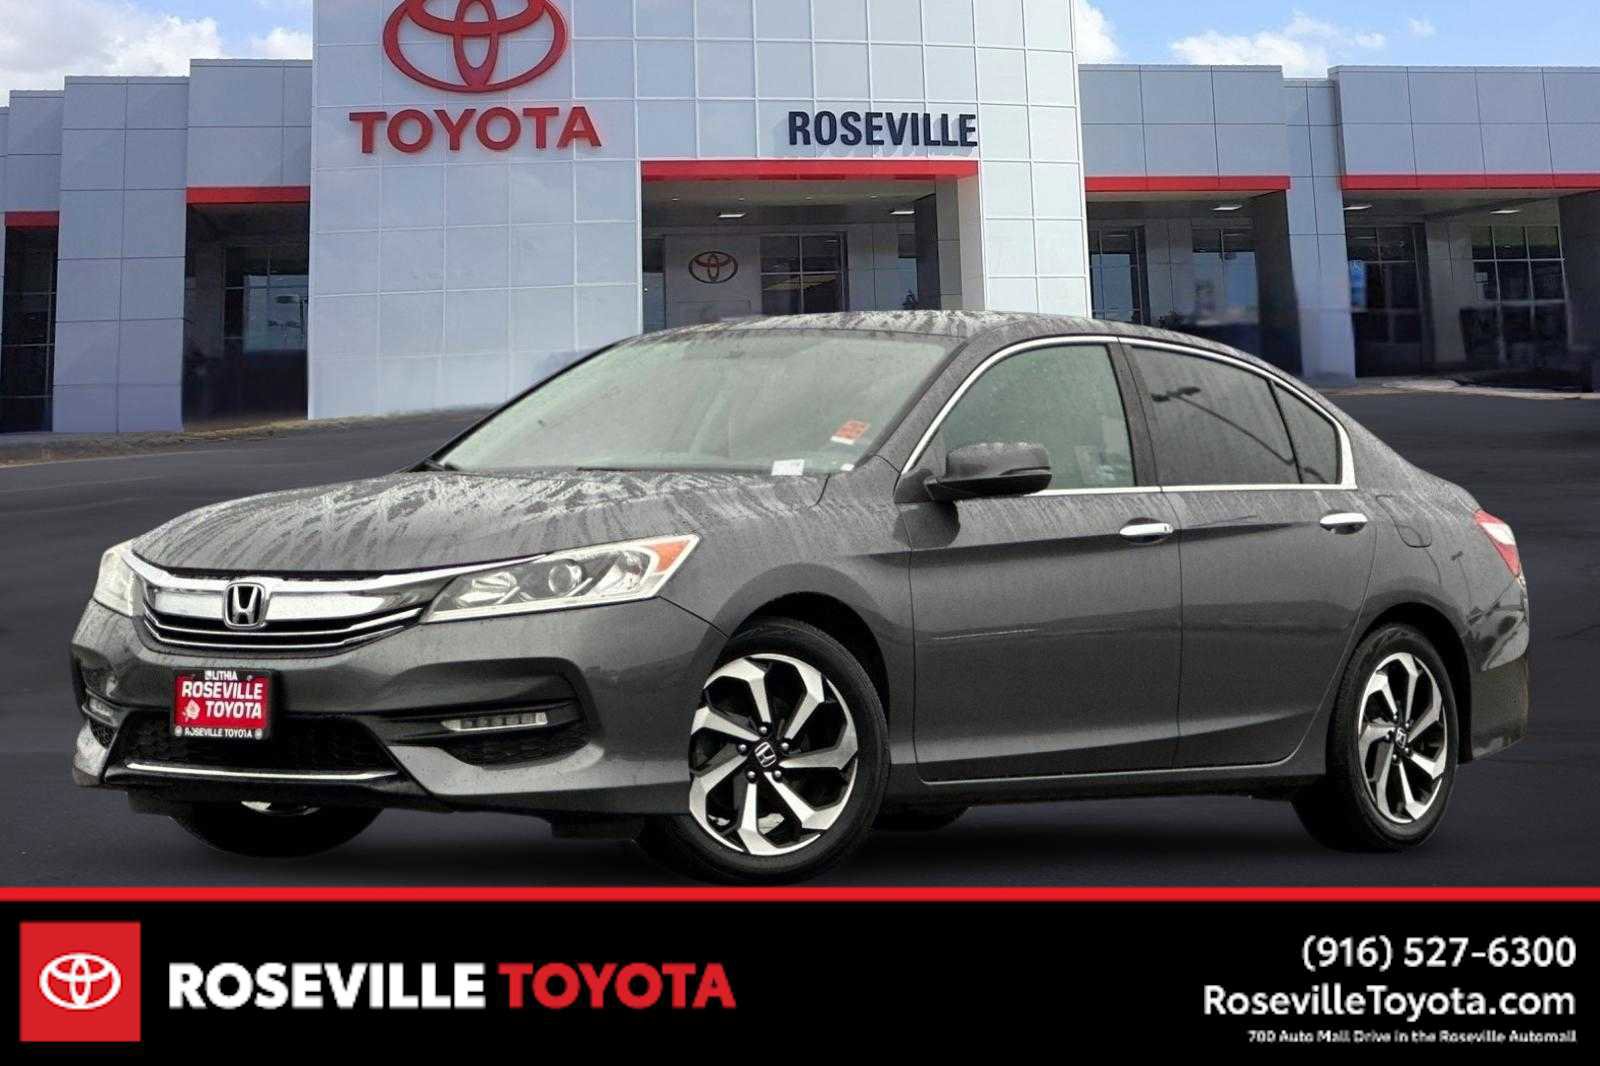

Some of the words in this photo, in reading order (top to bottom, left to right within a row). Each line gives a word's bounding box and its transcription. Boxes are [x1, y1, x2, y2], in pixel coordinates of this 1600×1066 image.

[349, 105, 602, 154] TOYOTA
[788, 110, 978, 147] ROSEVILLE
[181, 680, 263, 699] ROSEVILLE
[205, 700, 262, 719] TOYOTA
[184, 727, 222, 737] ROSEVILLE
[224, 728, 253, 738] TOYOTA
